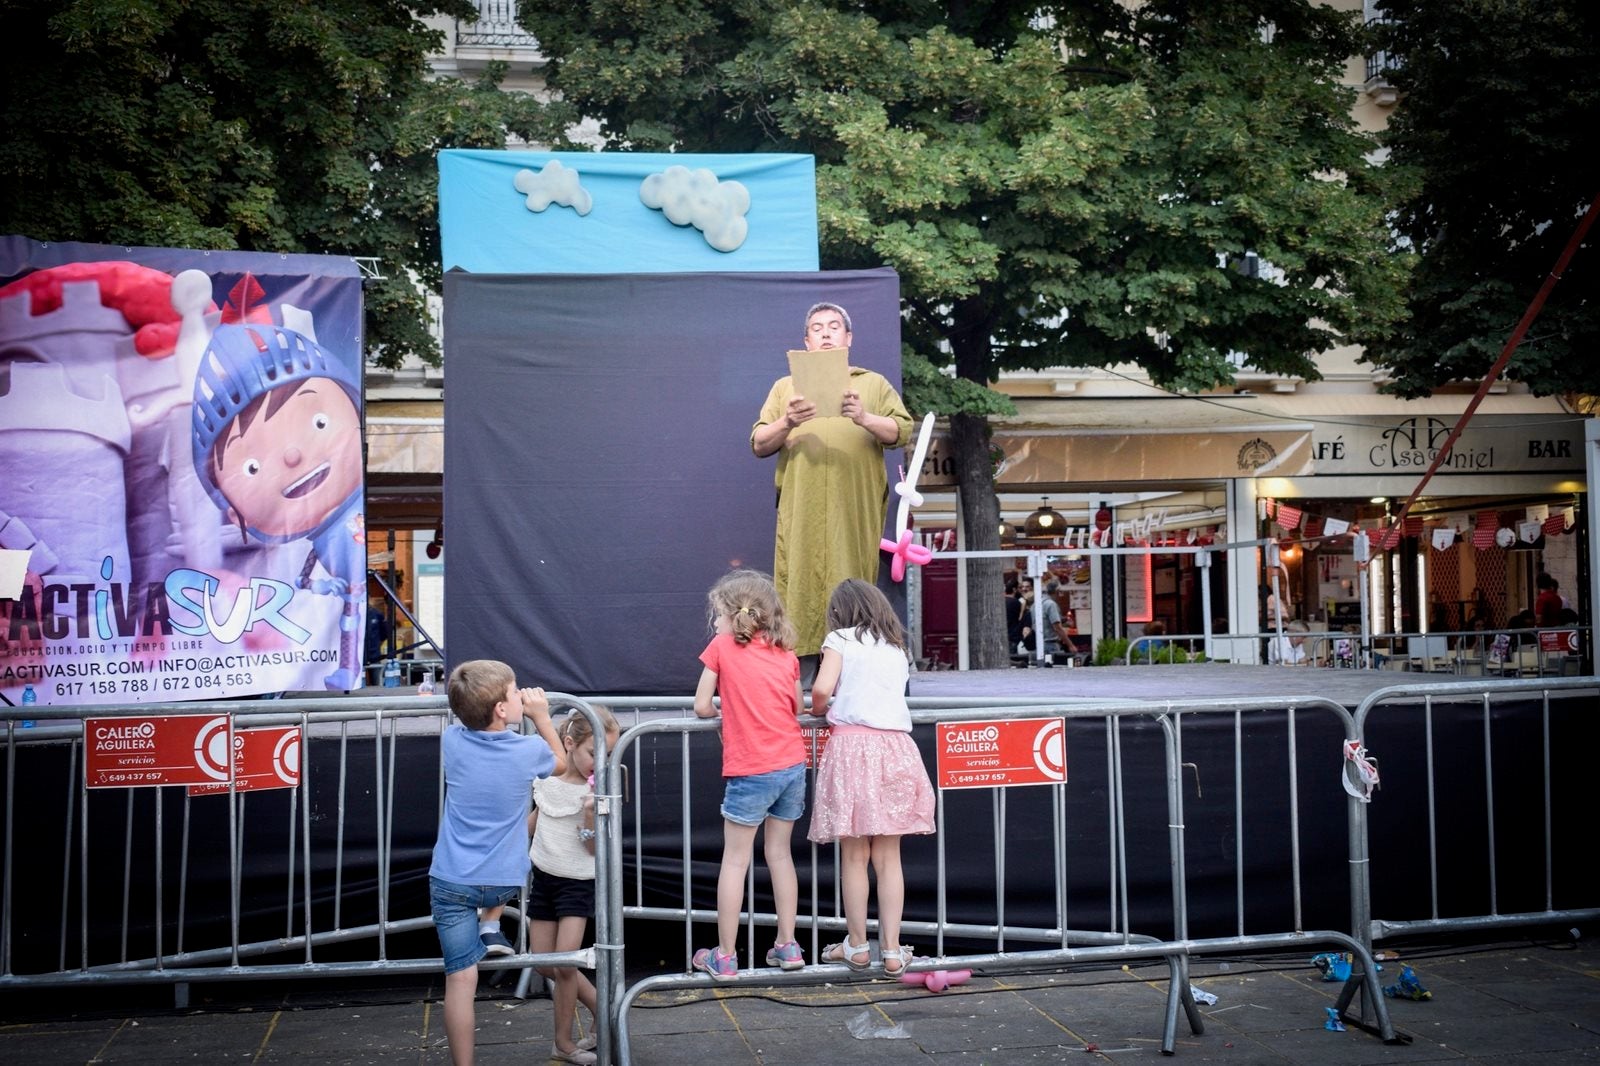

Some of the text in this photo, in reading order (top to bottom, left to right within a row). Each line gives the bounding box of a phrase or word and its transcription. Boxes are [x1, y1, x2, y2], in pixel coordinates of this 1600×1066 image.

[1528, 440, 1572, 459] BAR
[112, 643, 118, 652] Y
[123, 641, 166, 652] TIEMPO
[171, 640, 203, 651] LIBRE
[159, 649, 338, 673] INFO@ACTIVASUR.COM
[56, 683, 84, 696] 617
[90, 681, 117, 694] 158
[122, 679, 149, 693] 788
[163, 677, 190, 691] 672
[194, 676, 222, 689] 084
[226, 672, 254, 687] 563
[95, 722, 156, 740] CALERO
[946, 725, 999, 743] CALERO
[95, 739, 155, 751] AGUILERA
[946, 742, 999, 753] AGUILERA
[118, 755, 156, 765] servicios
[966, 758, 1000, 767] servicios
[109, 772, 162, 782] 649 437 657
[958, 775, 974, 783] 649
